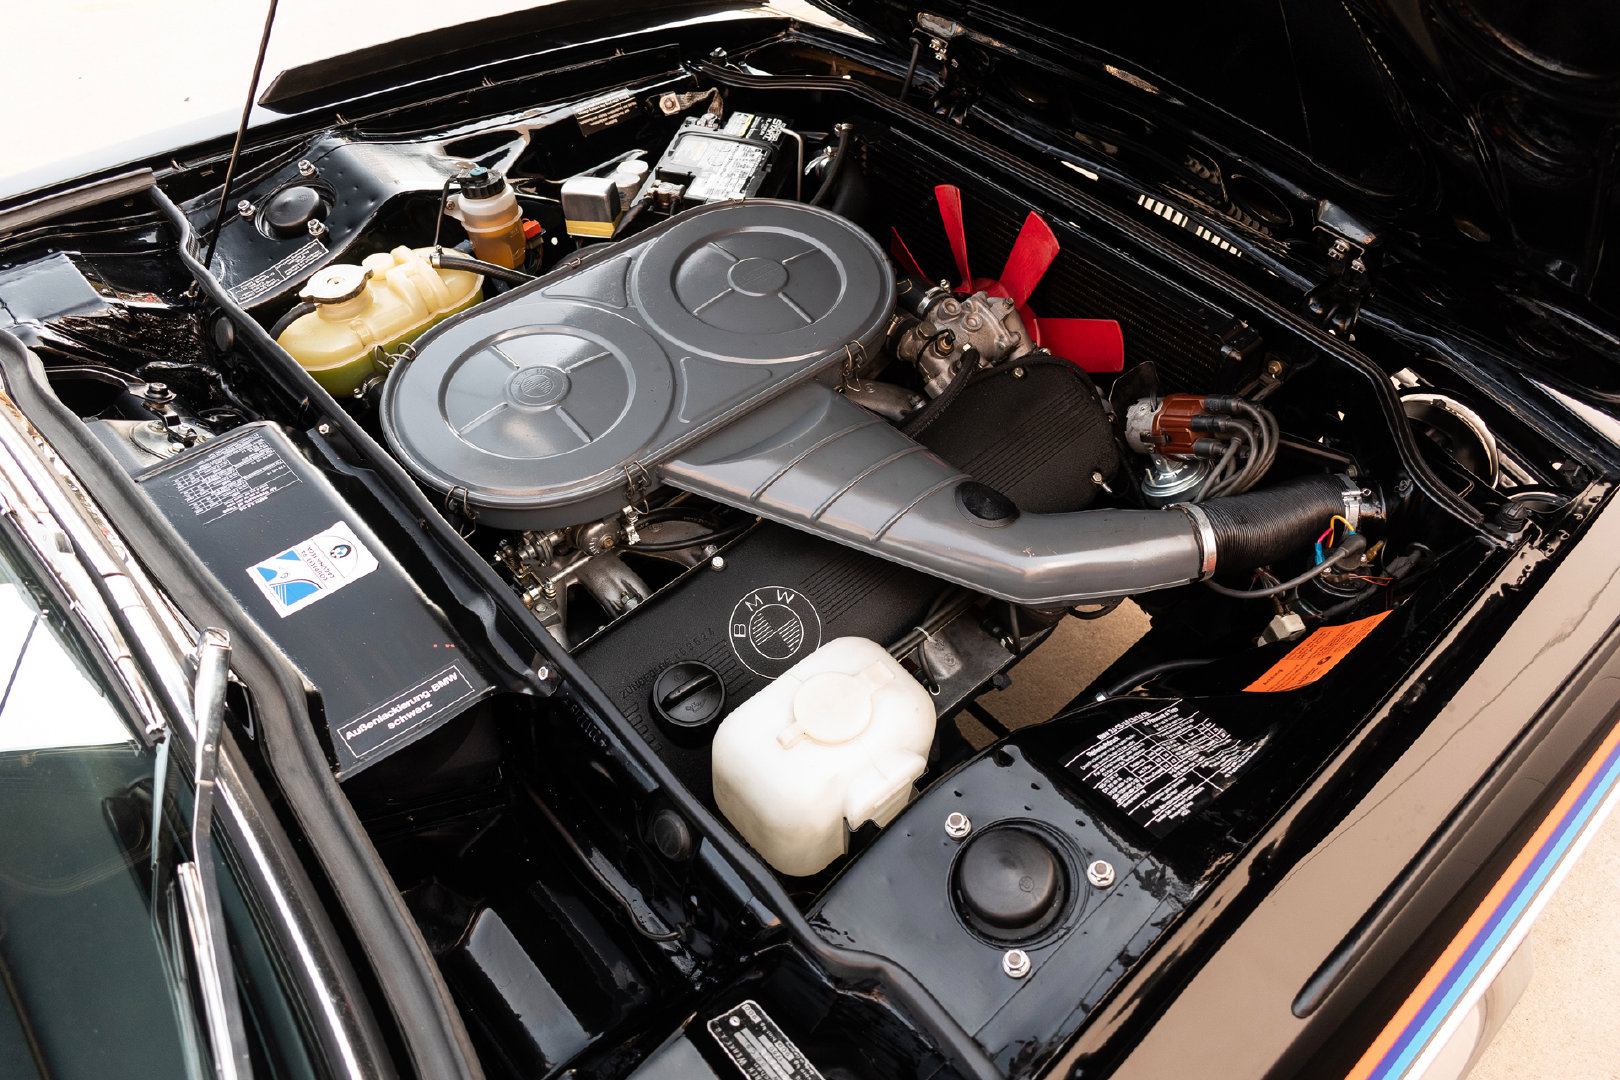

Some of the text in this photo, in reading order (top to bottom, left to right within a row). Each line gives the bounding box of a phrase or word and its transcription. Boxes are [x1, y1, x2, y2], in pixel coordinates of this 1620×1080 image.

[733, 589, 796, 638] BMW
[345, 672, 459, 741] Außenlackierung-BMW
[387, 700, 434, 730] schwarz
[726, 1040, 748, 1066] WERKE
